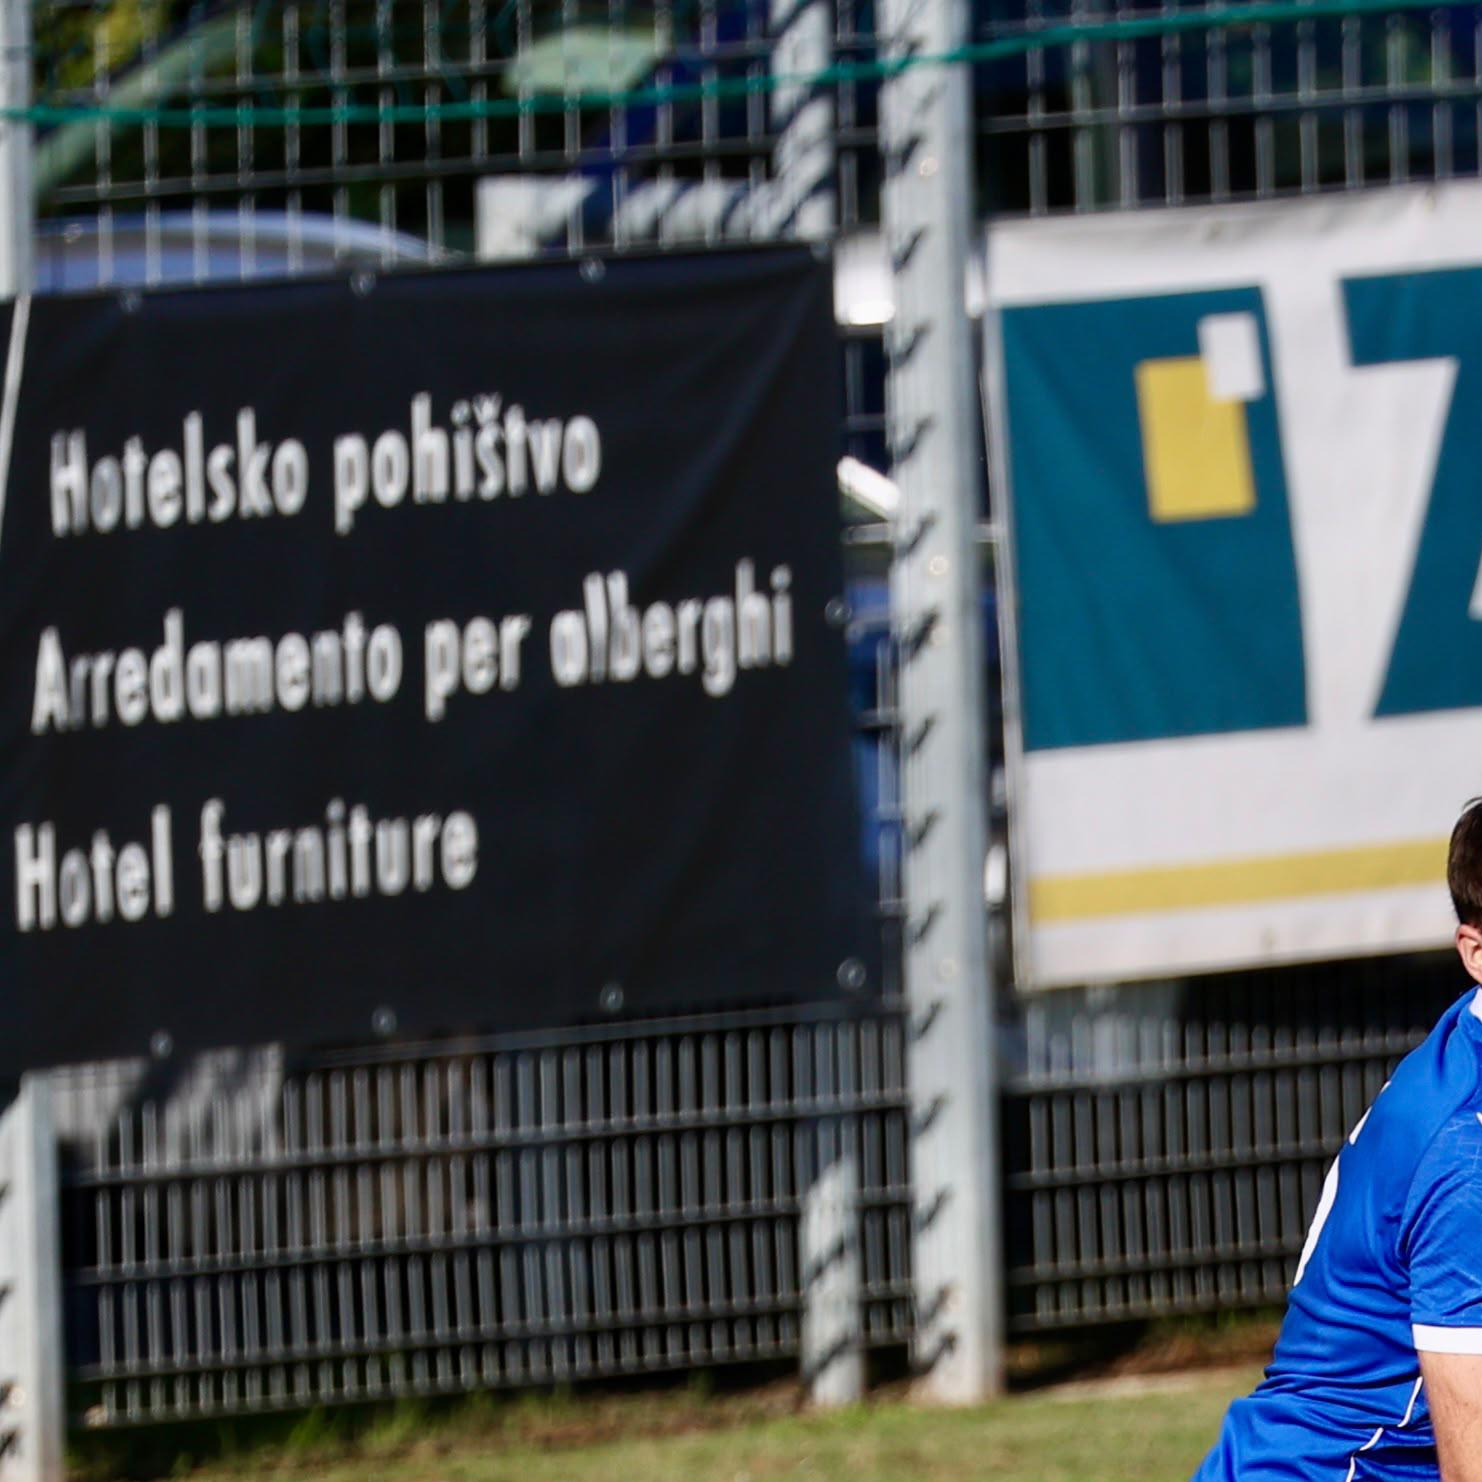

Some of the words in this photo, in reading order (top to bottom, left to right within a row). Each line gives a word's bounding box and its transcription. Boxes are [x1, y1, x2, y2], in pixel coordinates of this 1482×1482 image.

[51, 406, 308, 537] Hotelsko
[334, 392, 601, 535] pohištvo
[32, 608, 402, 734] Arredamento
[425, 613, 530, 722] per
[551, 558, 793, 697] alberghi
[15, 804, 172, 932] Hotel
[200, 798, 478, 912] furniture
